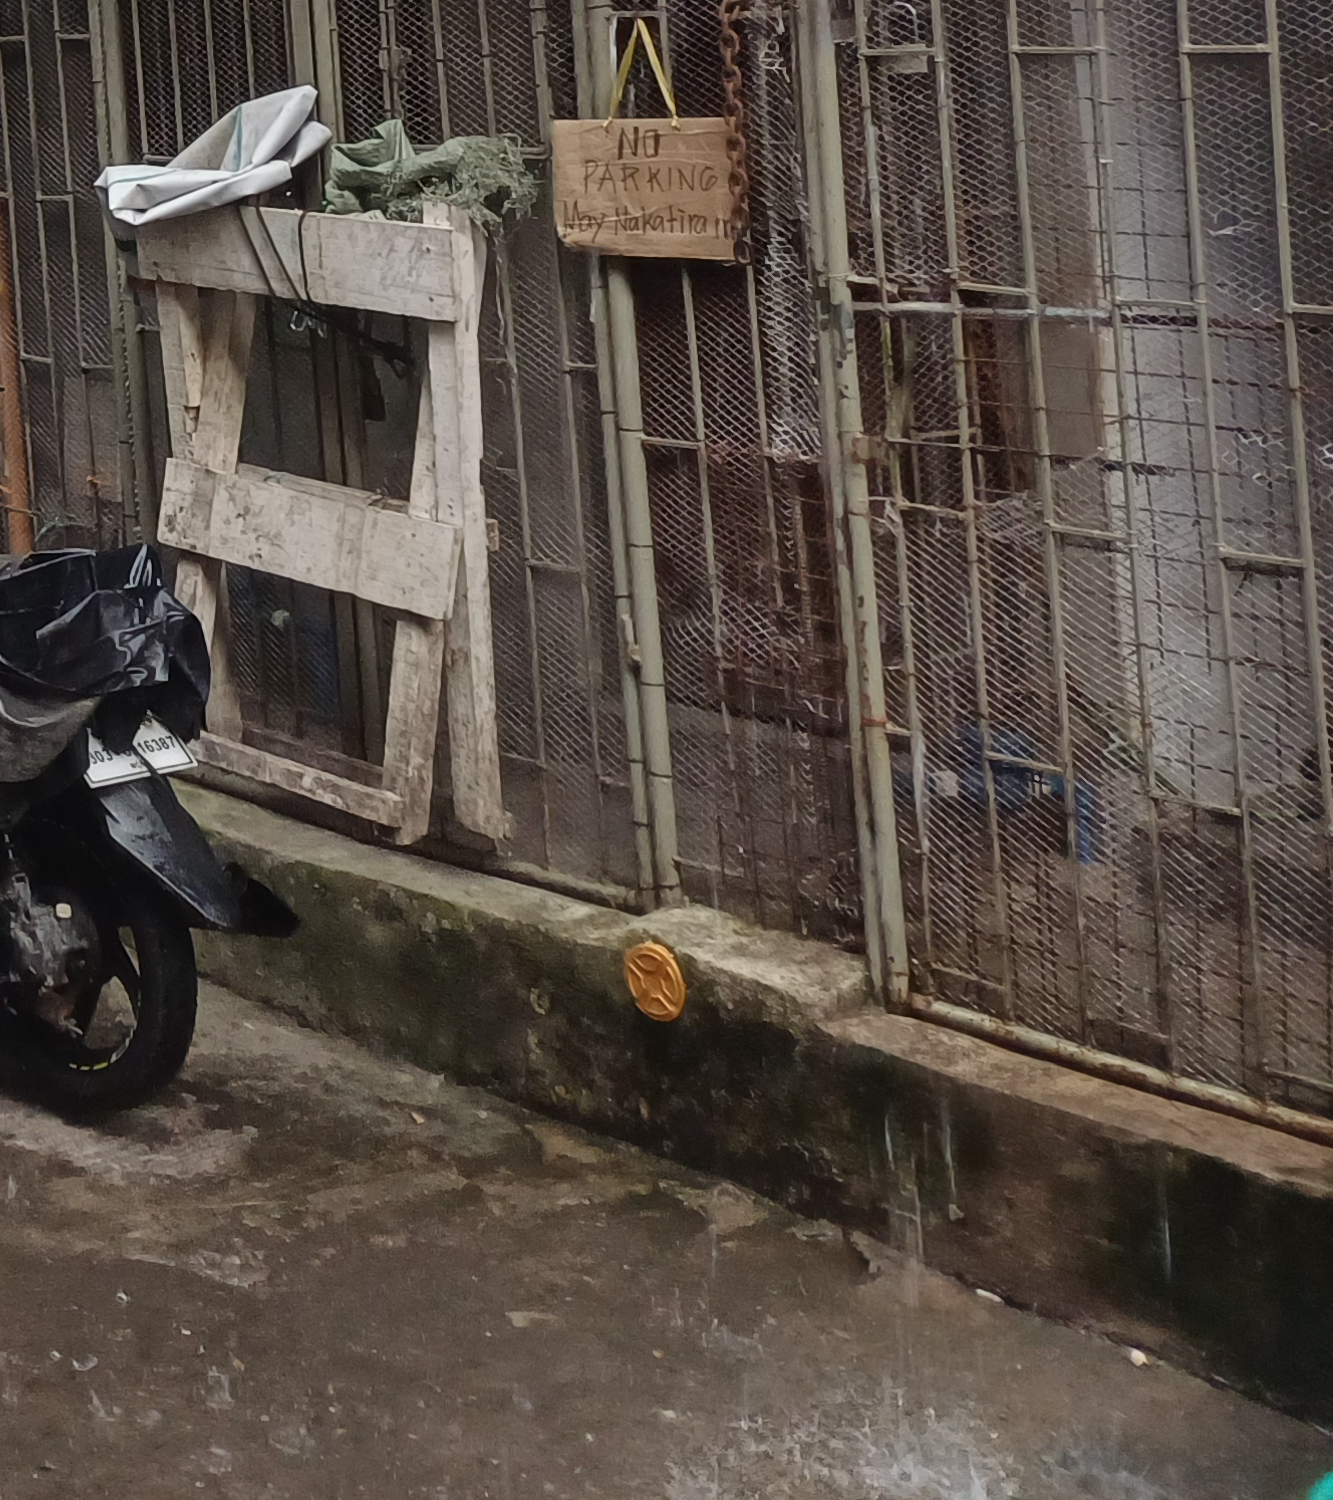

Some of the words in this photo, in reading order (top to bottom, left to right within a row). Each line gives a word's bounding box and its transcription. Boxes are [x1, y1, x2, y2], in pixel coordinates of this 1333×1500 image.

[617, 127, 662, 160] NO
[583, 160, 719, 196] PARKING
[137, 736, 176, 754] 16387
